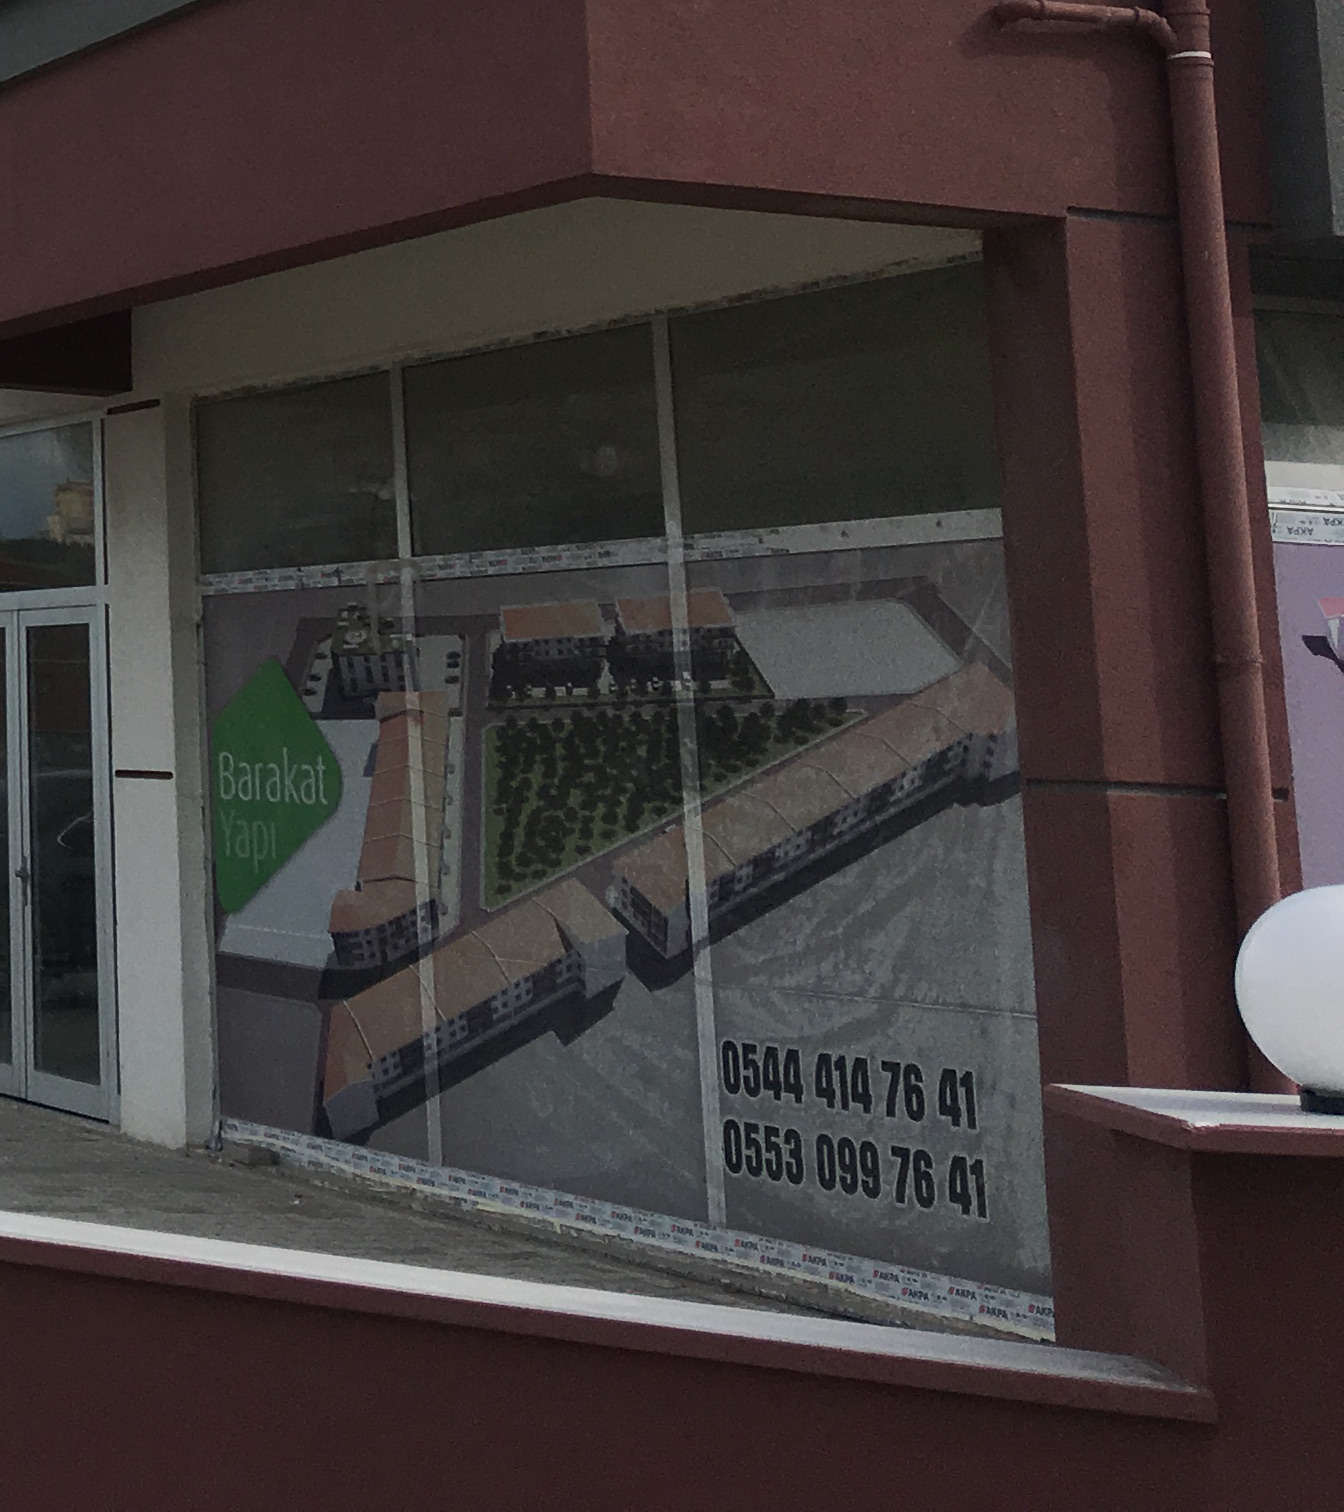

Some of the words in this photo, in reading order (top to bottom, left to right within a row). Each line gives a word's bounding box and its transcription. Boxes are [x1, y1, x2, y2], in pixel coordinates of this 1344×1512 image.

[218, 747, 328, 805] Barakat
[220, 809, 276, 874] Yapı
[721, 1040, 804, 1104] 0544
[815, 1053, 872, 1114] 414
[881, 1060, 925, 1123] 76
[938, 1068, 978, 1130] 41
[723, 1118, 804, 1185] 0553
[815, 1133, 882, 1199] 099
[890, 1145, 936, 1209] 76
[948, 1155, 988, 1219] 41
